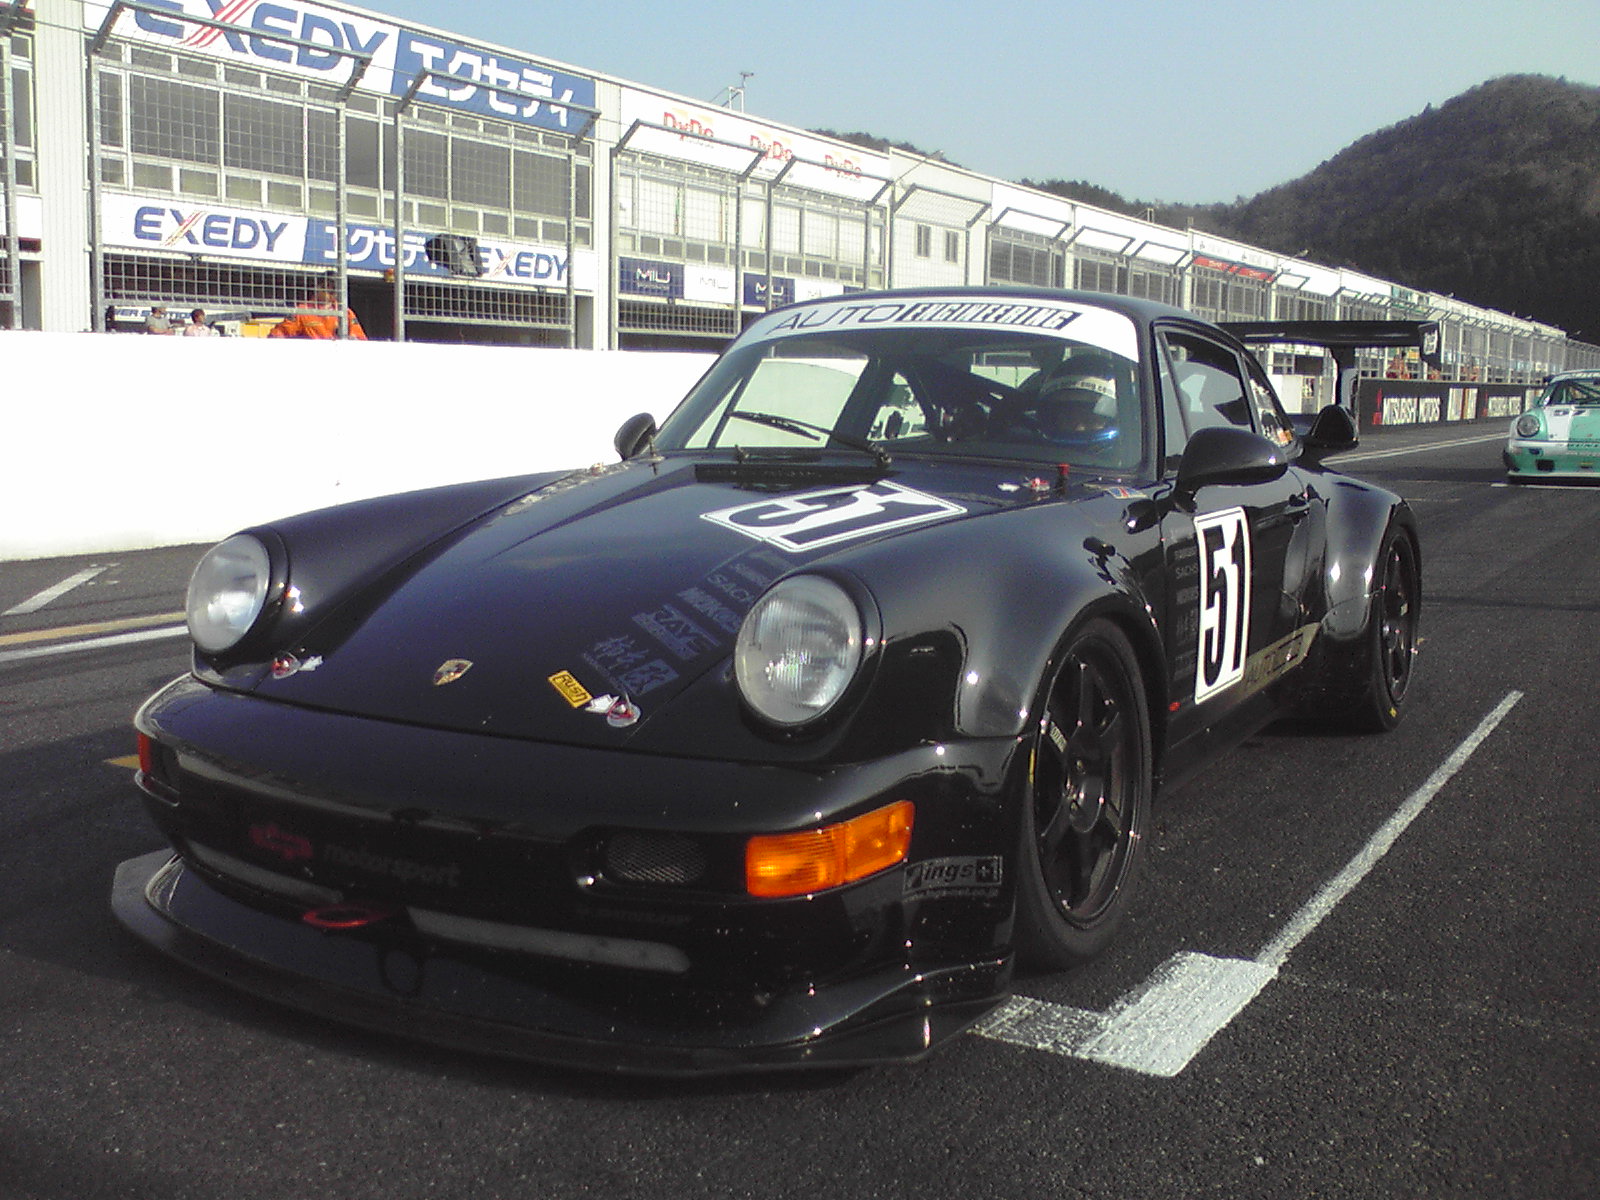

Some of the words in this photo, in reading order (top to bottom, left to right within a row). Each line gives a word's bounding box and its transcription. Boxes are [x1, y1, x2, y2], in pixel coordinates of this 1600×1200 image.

[135, 0, 389, 71] EXEDY
[407, 40, 574, 127] エクセディ
[134, 206, 289, 252] EXEDY
[325, 226, 438, 270] エクセデ
[766, 303, 905, 335] AUTO
[729, 481, 953, 547] 51
[1202, 518, 1245, 687] 51
